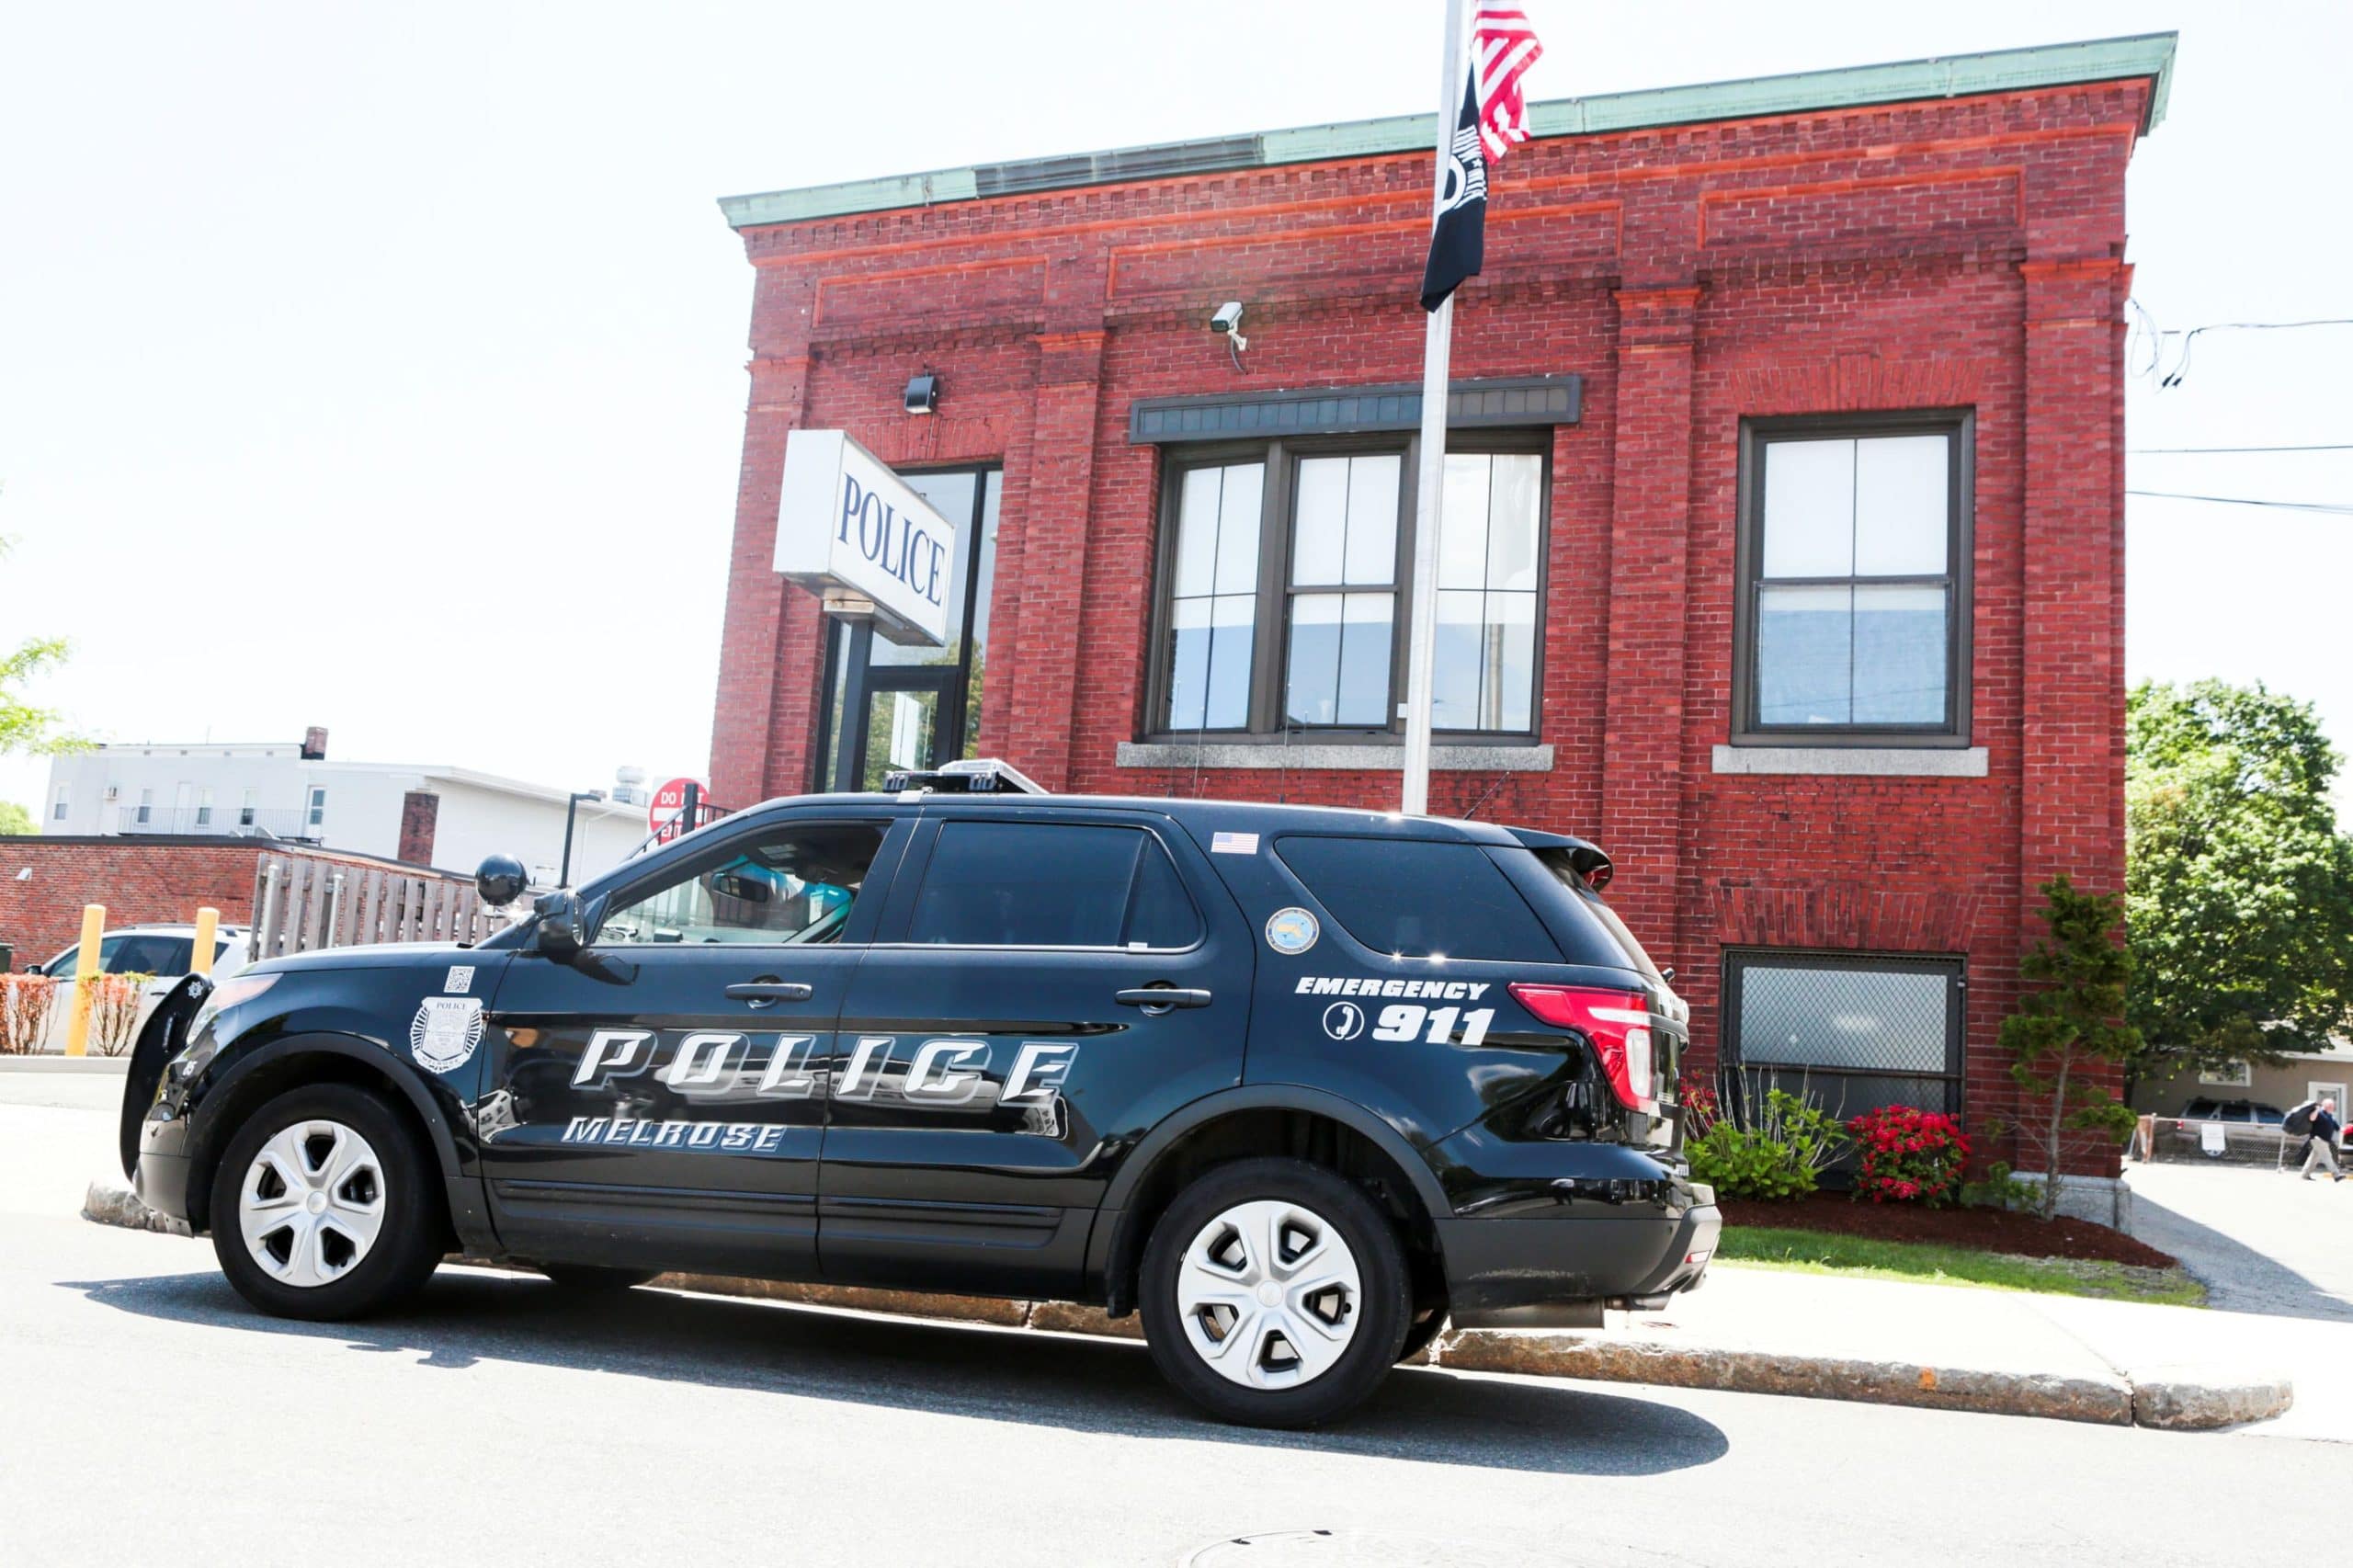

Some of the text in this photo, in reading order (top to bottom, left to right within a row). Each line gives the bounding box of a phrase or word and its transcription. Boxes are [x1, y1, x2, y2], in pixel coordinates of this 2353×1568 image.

[837, 472, 946, 608] POLICE
[661, 791, 677, 805] DO
[1294, 976, 1491, 1000] EMERGENCY
[1372, 1005, 1495, 1047] 911
[569, 1028, 1080, 1108] POLICE
[561, 1116, 787, 1153] MELROSE
